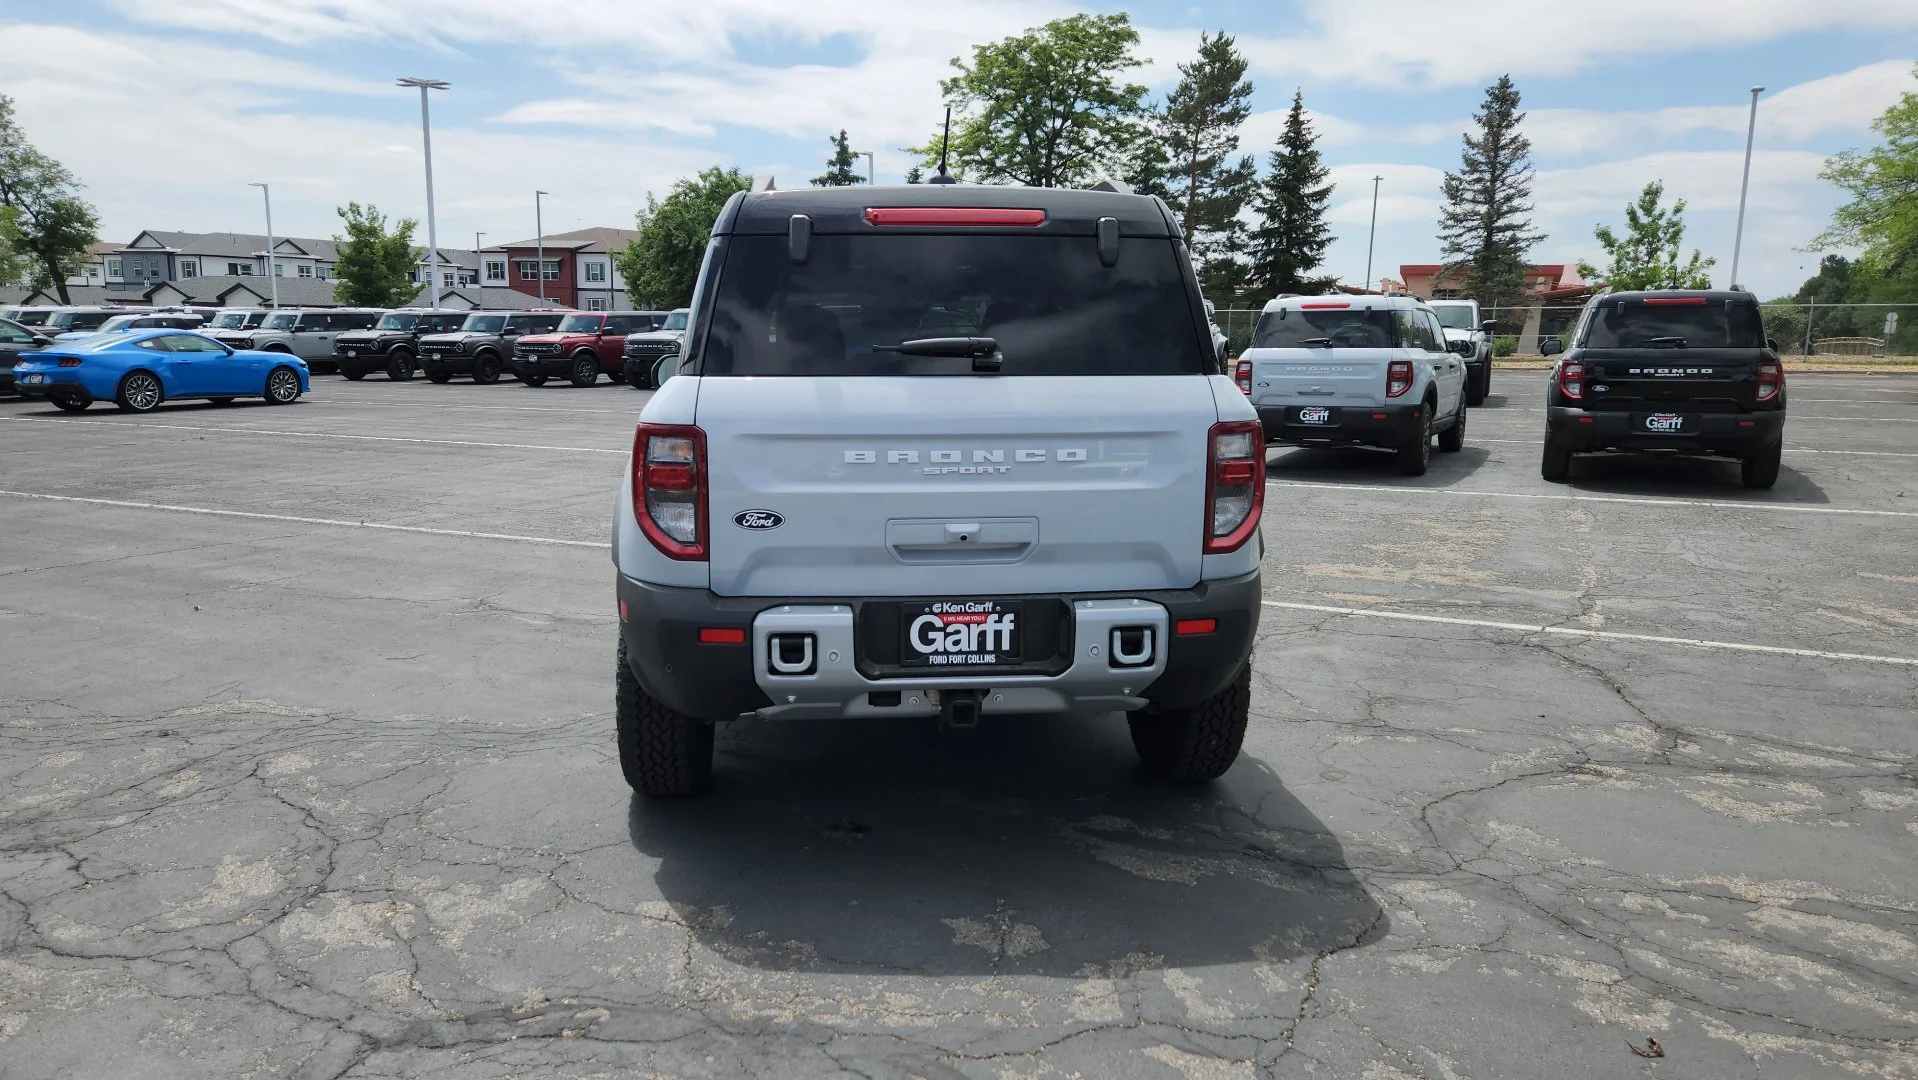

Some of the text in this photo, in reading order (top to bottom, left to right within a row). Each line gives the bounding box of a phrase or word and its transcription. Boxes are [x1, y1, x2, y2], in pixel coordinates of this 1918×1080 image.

[1300, 409, 1330, 421] Garff
[1645, 416, 1683, 429] Garff
[844, 449, 1088, 464] BRONCO
[923, 466, 1012, 475] SPORT
[742, 512, 775, 527] Ford
[942, 602, 965, 613] Ken
[965, 601, 994, 612] Garff
[909, 613, 1015, 654] Garff
[929, 654, 996, 664] FORD FORT COLLINS
